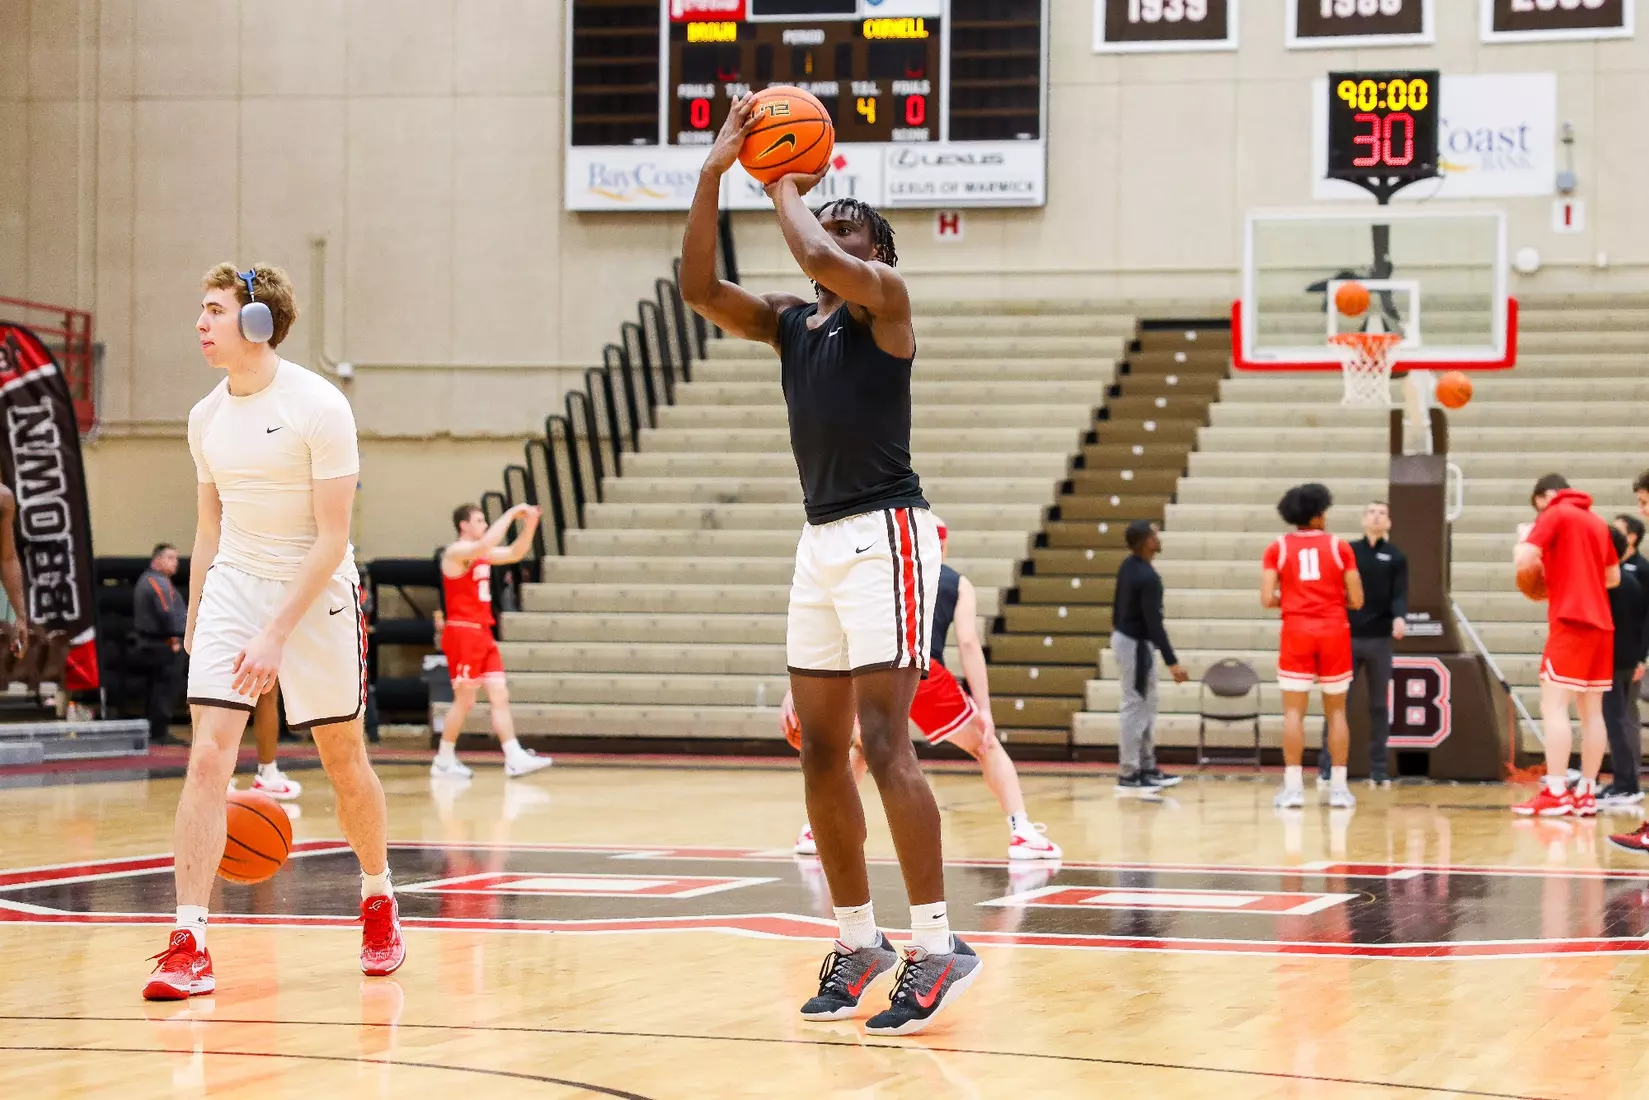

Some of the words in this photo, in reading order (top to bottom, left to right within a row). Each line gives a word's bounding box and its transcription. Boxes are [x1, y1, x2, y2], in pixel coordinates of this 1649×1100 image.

[856, 97, 876, 124] 4
[905, 94, 925, 126] 0
[1337, 79, 1428, 111] 90:00
[690, 98, 711, 129] 0
[1352, 112, 1414, 166] 30
[1438, 117, 1532, 152] oast
[921, 152, 1004, 165] LEXUS
[938, 211, 960, 235] H
[7, 396, 80, 624] BROWN
[1298, 546, 1321, 581] 11
[1386, 656, 1451, 748] B
